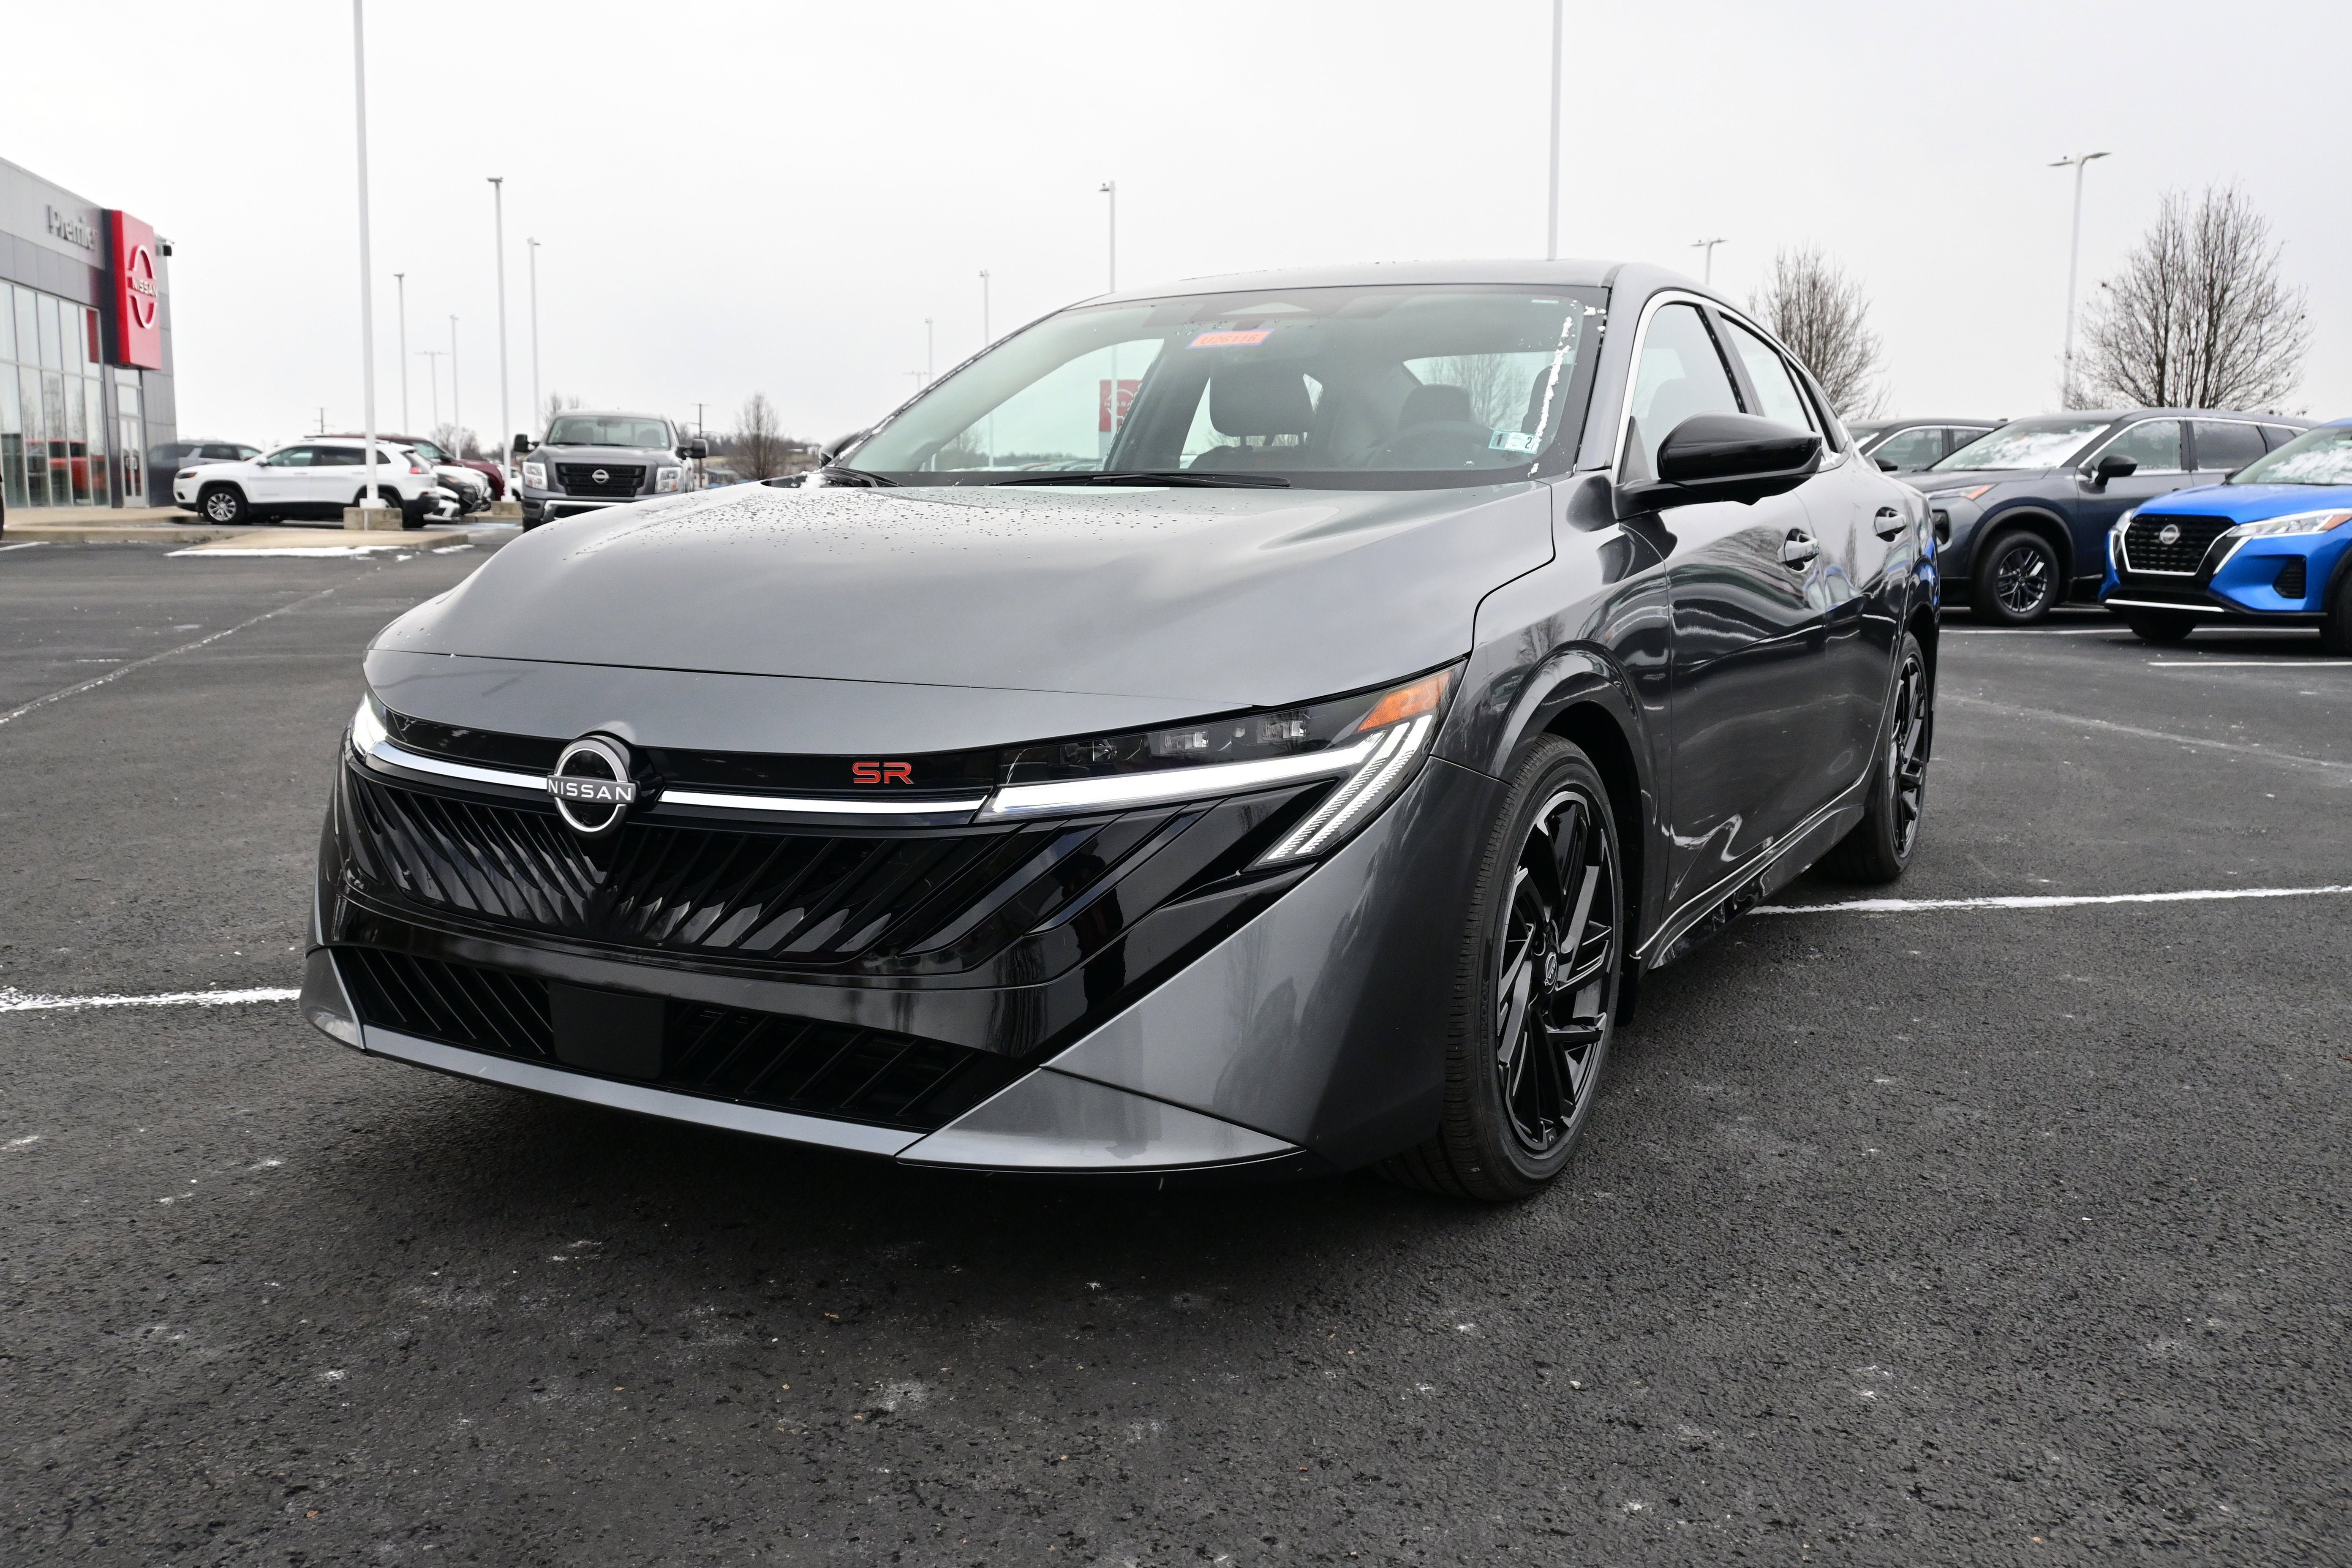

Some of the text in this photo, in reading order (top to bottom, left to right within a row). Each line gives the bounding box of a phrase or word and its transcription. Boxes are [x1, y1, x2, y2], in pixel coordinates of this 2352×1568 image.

[133, 279, 158, 297] NISSAN
[852, 761, 915, 784] SR
[548, 779, 632, 801] NISSAN
